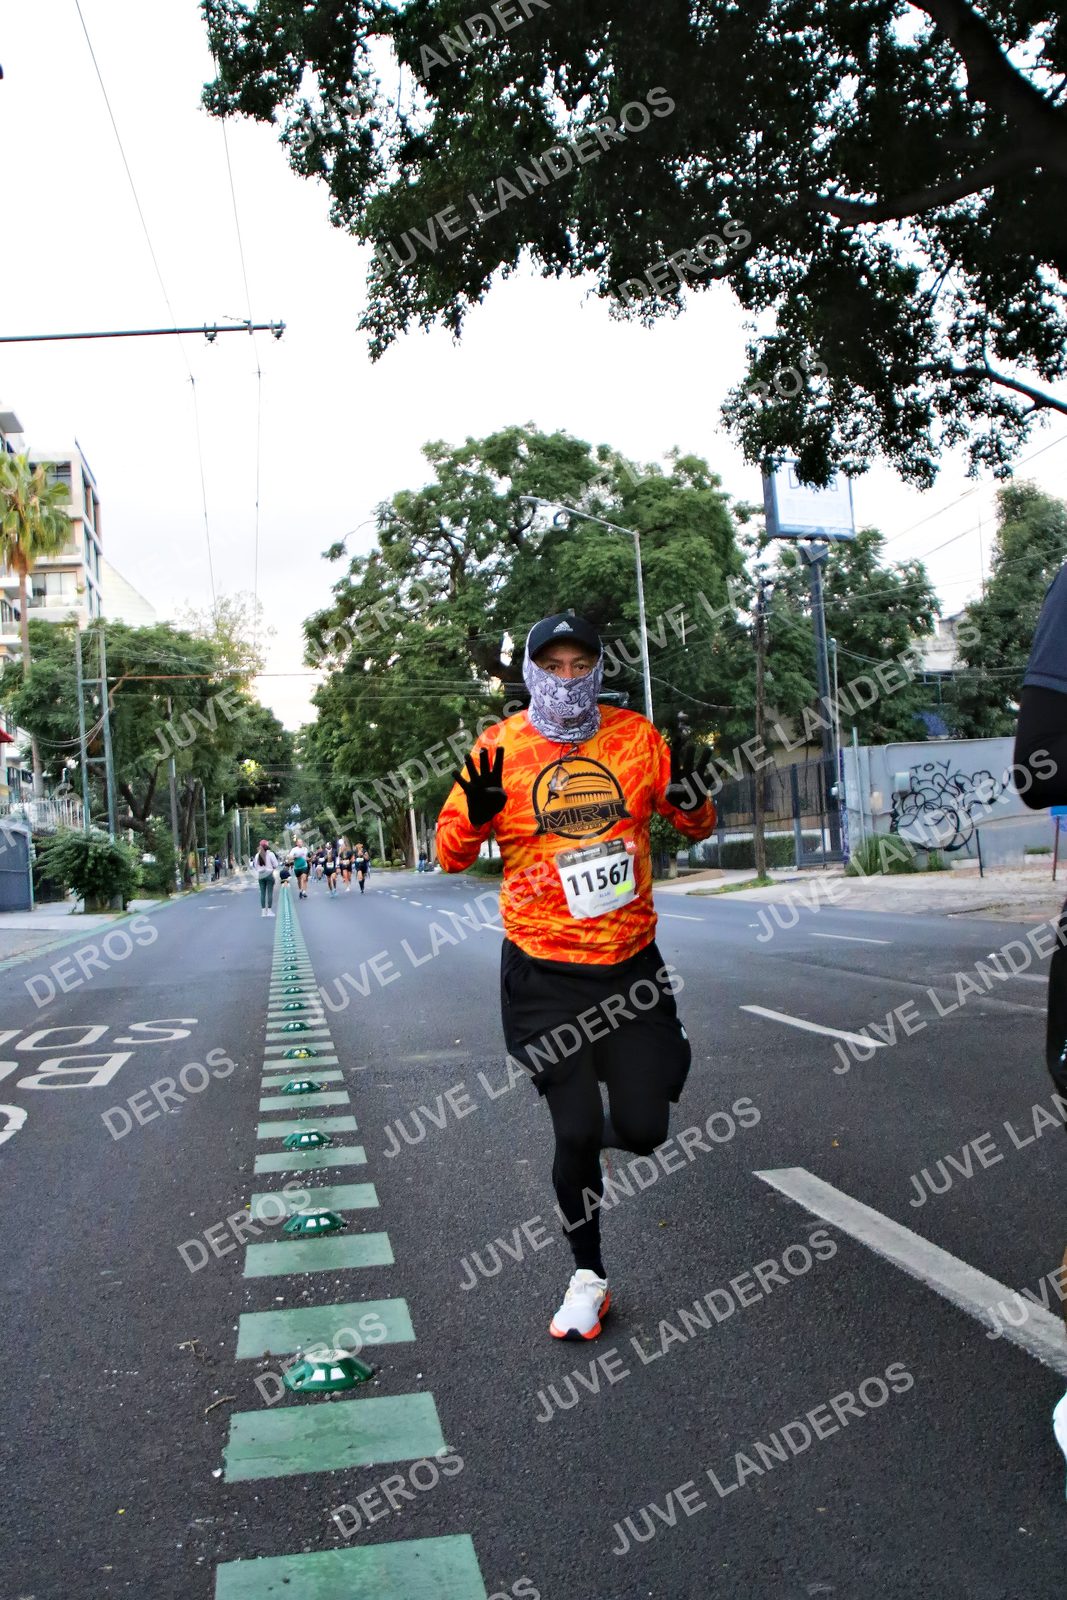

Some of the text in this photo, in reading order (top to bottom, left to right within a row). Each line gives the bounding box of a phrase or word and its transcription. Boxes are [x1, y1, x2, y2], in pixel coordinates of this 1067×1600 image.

[910, 760, 951, 776] TOY
[541, 802, 623, 831] MRT
[567, 859, 629, 896] 11567
